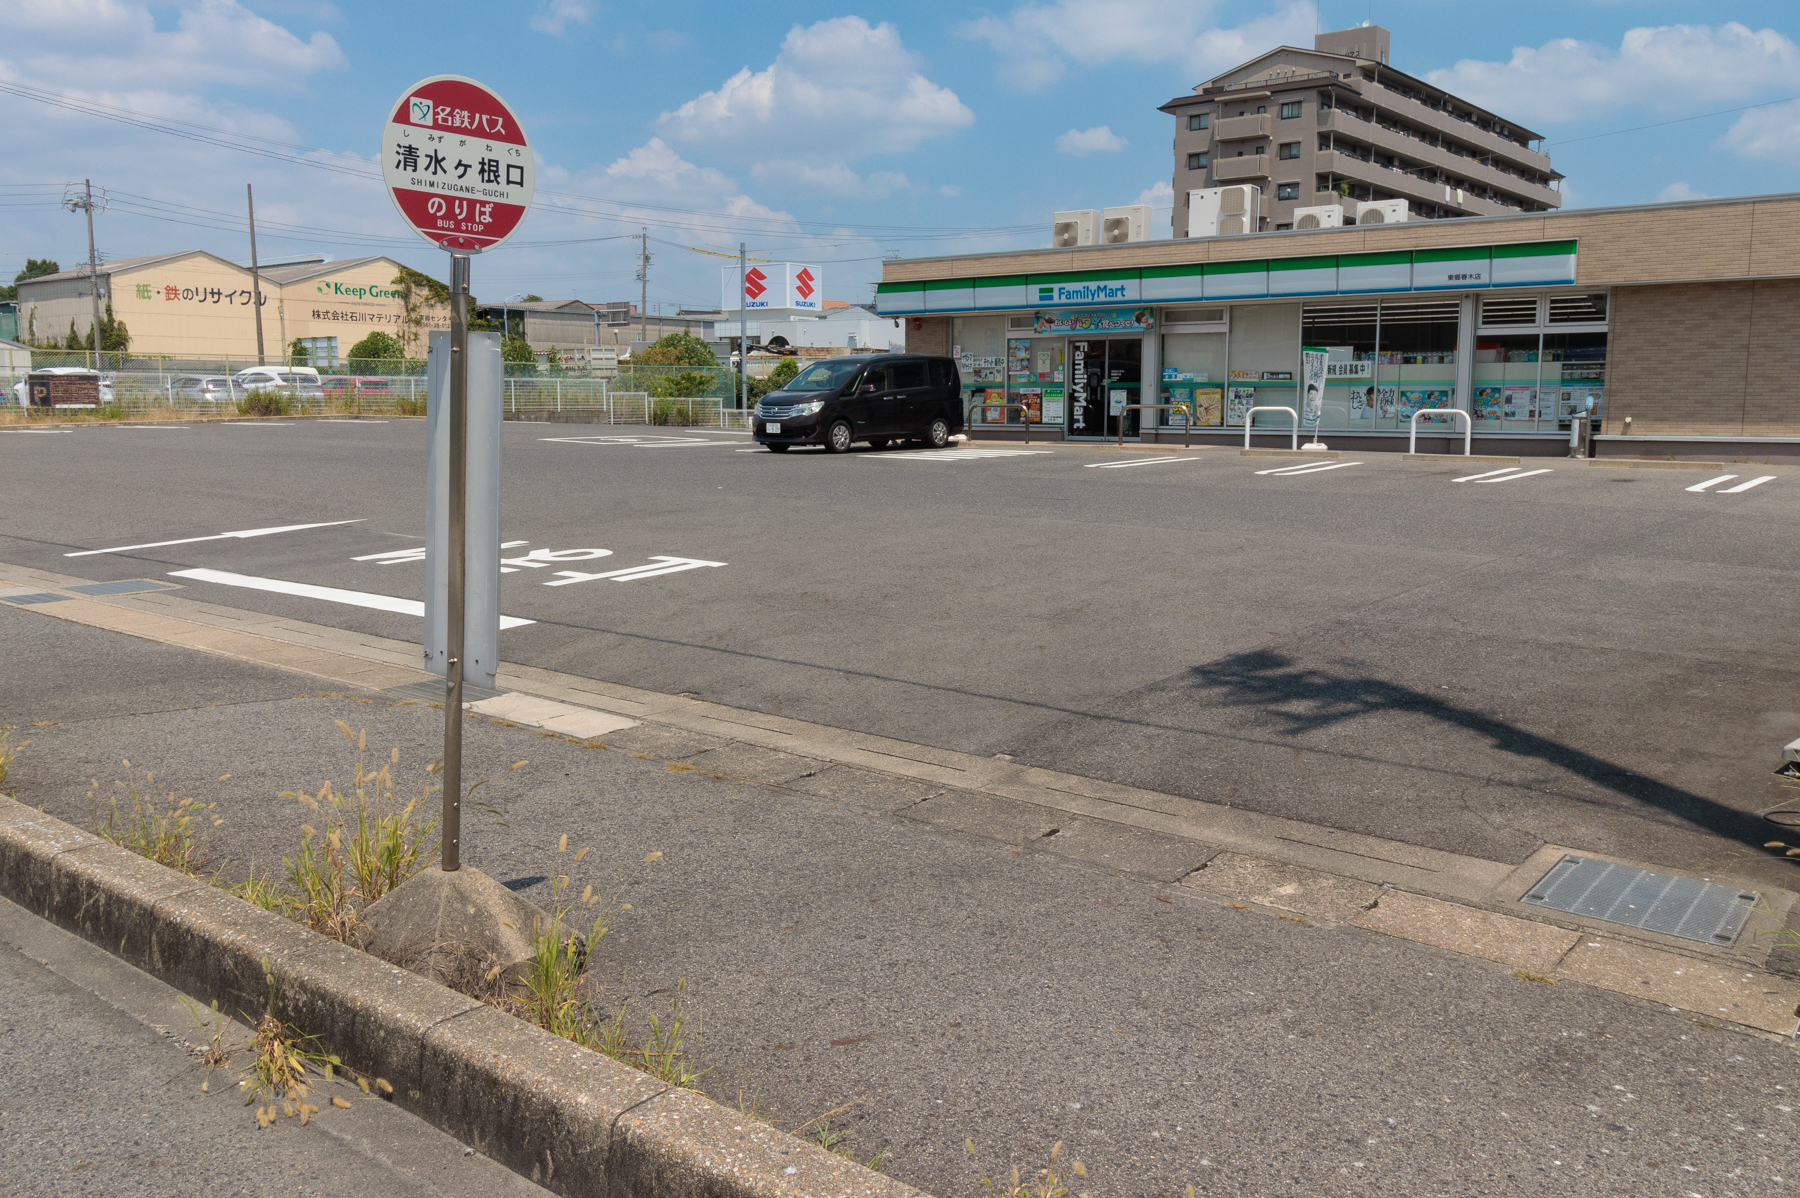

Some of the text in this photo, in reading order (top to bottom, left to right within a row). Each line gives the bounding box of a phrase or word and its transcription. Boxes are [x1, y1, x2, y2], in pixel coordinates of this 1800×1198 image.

[435, 105, 506, 135] 名鉄バス
[410, 177, 509, 199] SHIMIZUGANE-GUCHI
[427, 197, 494, 223] のりば
[437, 219, 484, 232] BUS STOP
[1447, 273, 1481, 281] 東郷春木店
[135, 283, 267, 306] 紙・鉄のリサイクル
[334, 282, 367, 300] Keep
[1058, 284, 1126, 301] FamilyMart
[795, 300, 816, 308] SUZUKI
[312, 308, 409, 325] 株式会社石川マテリアル
[1072, 341, 1088, 429] FamilyMart
